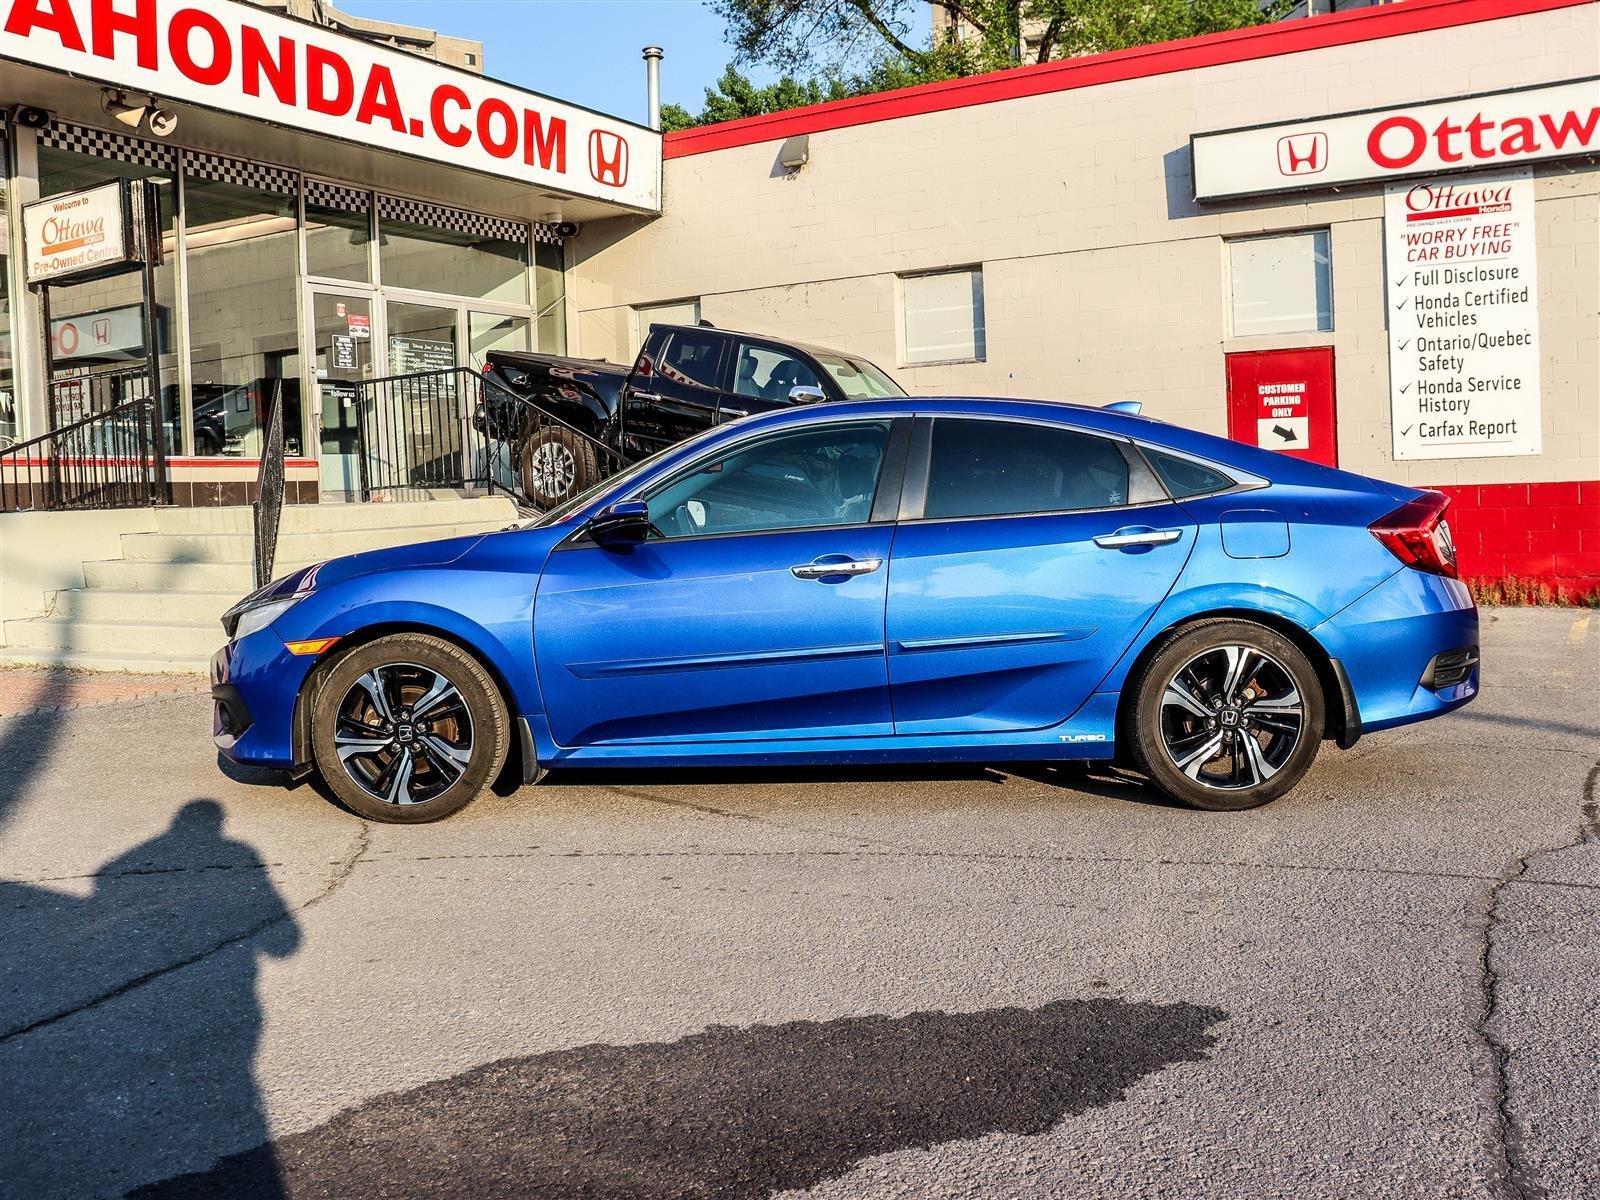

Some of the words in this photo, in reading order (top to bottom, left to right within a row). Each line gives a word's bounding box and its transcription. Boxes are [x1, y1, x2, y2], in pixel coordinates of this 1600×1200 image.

[53, 200, 81, 212] Welcome
[1405, 183, 1512, 211] Ottawa
[1479, 203, 1511, 213] Honda
[41, 216, 104, 245] Ottawa
[1400, 227, 1467, 247] "WORRY
[1473, 222, 1520, 240] FREE"
[33, 251, 84, 274] Pre-Owned
[87, 247, 118, 261] Centre
[1407, 246, 1439, 262] CAR
[1445, 239, 1511, 259] BUYING
[1414, 269, 1439, 287] Full
[1444, 266, 1519, 284] Disclosure
[1415, 292, 1460, 311] Honda
[1464, 286, 1528, 307] Certified
[1416, 310, 1477, 328] Vehicles
[1417, 330, 1532, 352] Ontario/Quebec
[1419, 354, 1464, 374] Safety
[1258, 383, 1306, 395] CUSTOMER
[1418, 377, 1462, 395] Honda
[1468, 375, 1521, 392] Service
[1263, 395, 1301, 406] PARKING
[1419, 397, 1470, 415] History
[1271, 407, 1293, 417] ONLY
[1419, 421, 1464, 438] Carfax
[1469, 419, 1517, 439] Report
[1058, 734, 1106, 742] TURBO
